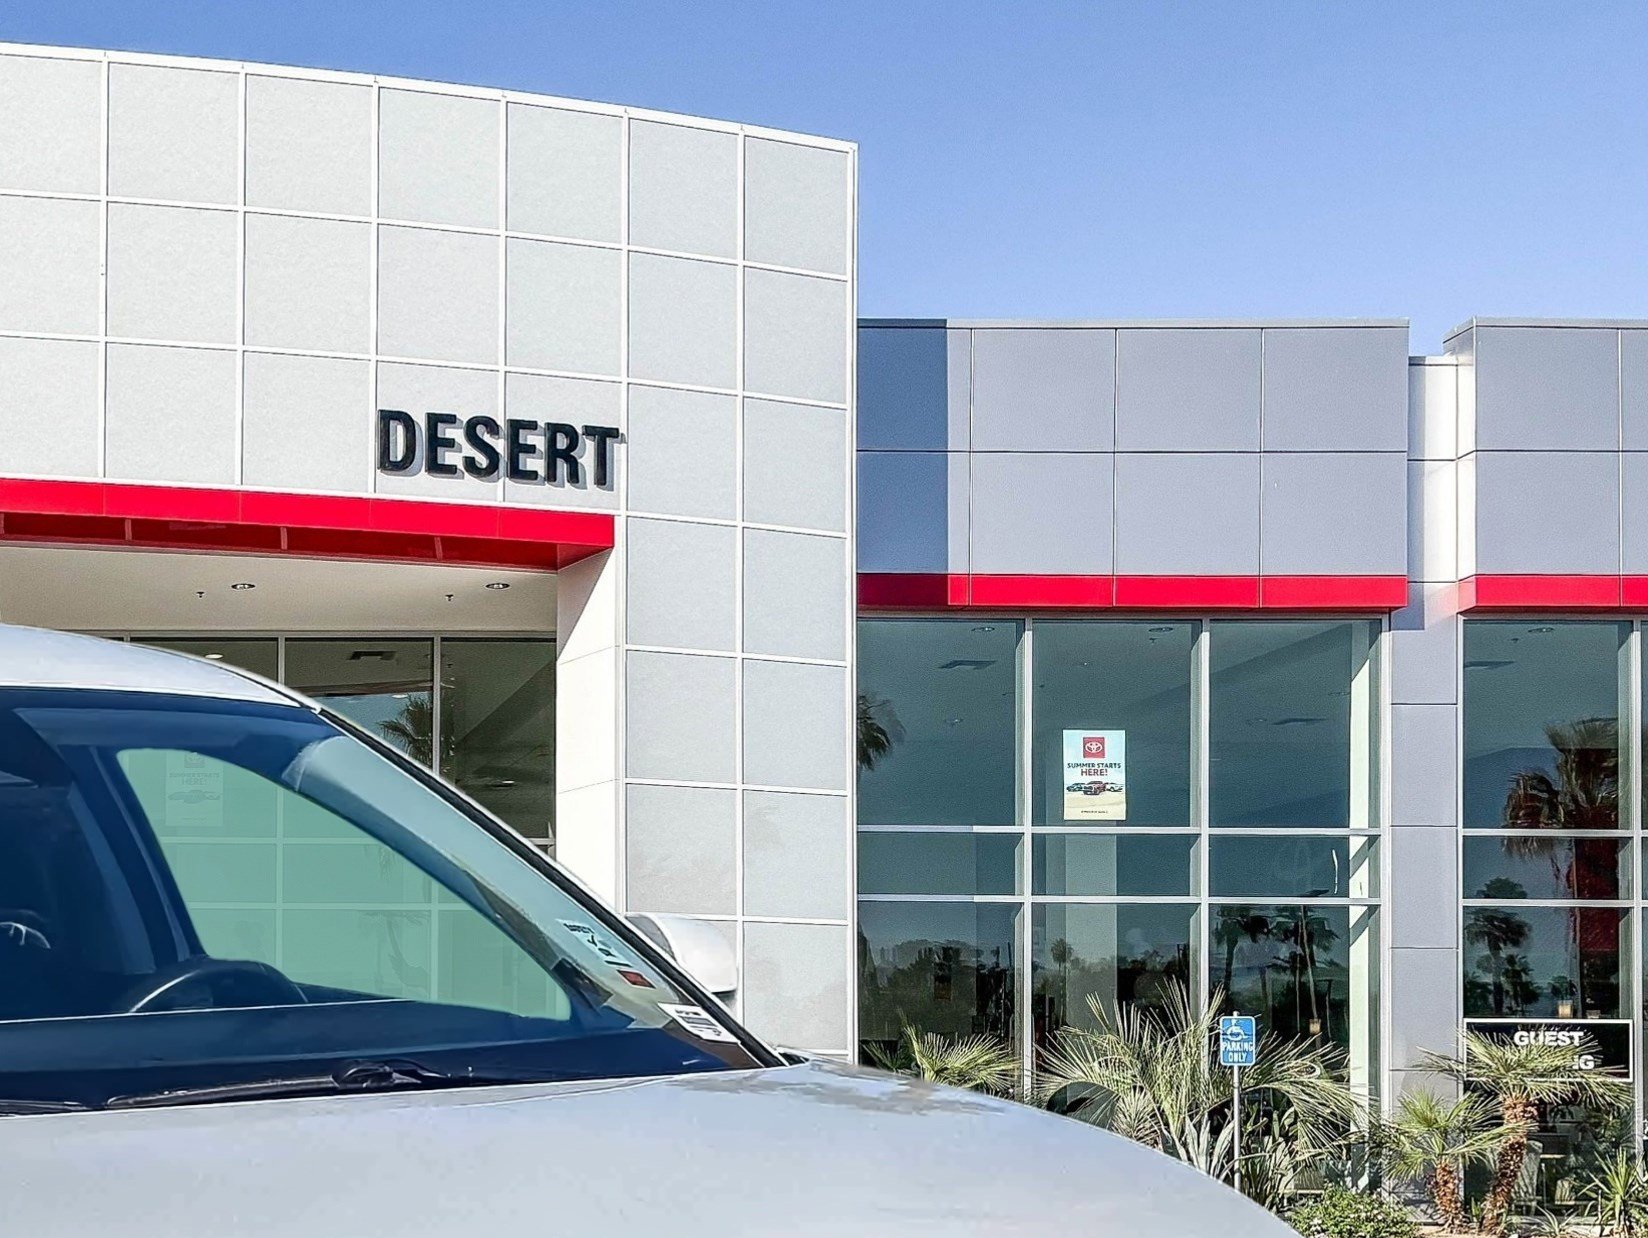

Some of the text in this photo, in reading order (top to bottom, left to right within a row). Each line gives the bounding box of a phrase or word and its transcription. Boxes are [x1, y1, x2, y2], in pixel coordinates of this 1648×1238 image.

[377, 409, 620, 487] DESERT
[1513, 1030, 1584, 1047] GUEST
[1222, 1042, 1253, 1052] PARKING
[1228, 1052, 1248, 1062] ONLY
